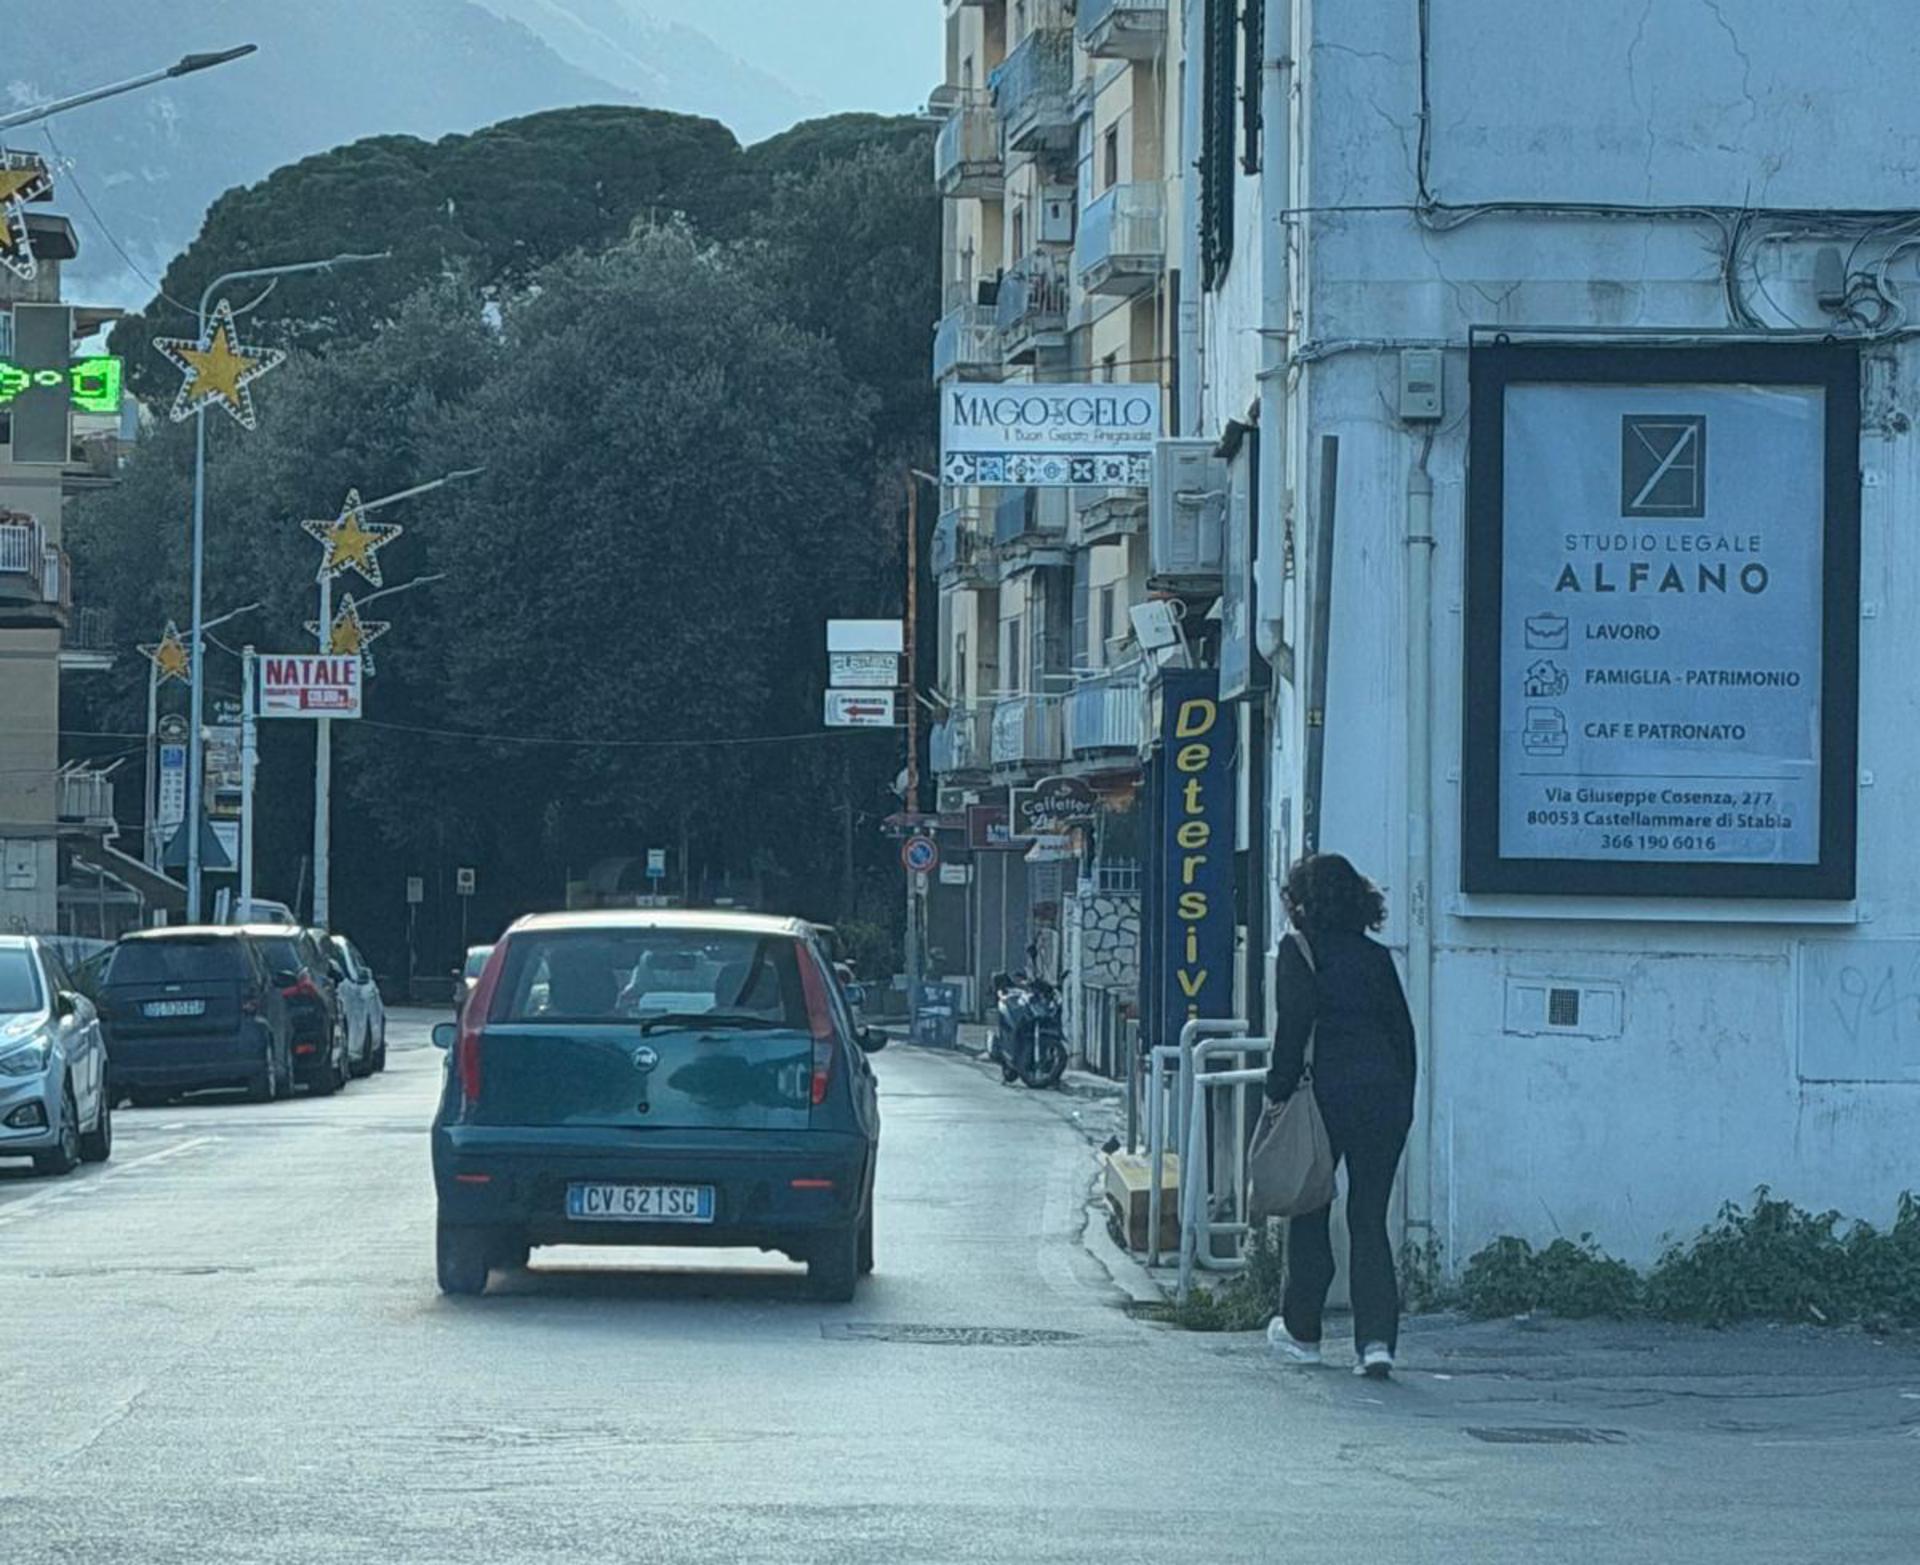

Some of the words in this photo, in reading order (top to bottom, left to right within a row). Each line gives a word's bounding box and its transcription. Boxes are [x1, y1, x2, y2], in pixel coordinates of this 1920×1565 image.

[953, 392, 1049, 426] MAGO
[1067, 398, 1151, 426] GELO
[1565, 534, 1656, 551] STUDIO
[1666, 535, 1761, 552] LEGALE
[1555, 562, 1769, 594] ALFANO
[1586, 624, 1660, 640] LAVORO
[266, 659, 357, 685] NATALE
[1585, 669, 1671, 685] FAMIGLIA
[1686, 670, 1800, 687] PATRIMONIO
[1584, 722, 1620, 739] CAF
[1624, 724, 1634, 739] E
[1638, 723, 1746, 741] PATRONATO
[1545, 788, 1572, 802] Via
[1576, 788, 1657, 807] Giuseppe
[1661, 789, 1737, 808] Cosenza,
[1742, 792, 1774, 805] 277
[1527, 810, 1580, 825] 80053
[1584, 811, 1713, 828] Castellammare
[1716, 812, 1733, 828] di
[1737, 814, 1792, 829] Stabia
[1601, 834, 1634, 849] 366
[1639, 835, 1670, 849] 190
[1673, 836, 1716, 850] 6016
[587, 1188, 614, 1212] CV
[623, 1188, 695, 1213] 621SG
